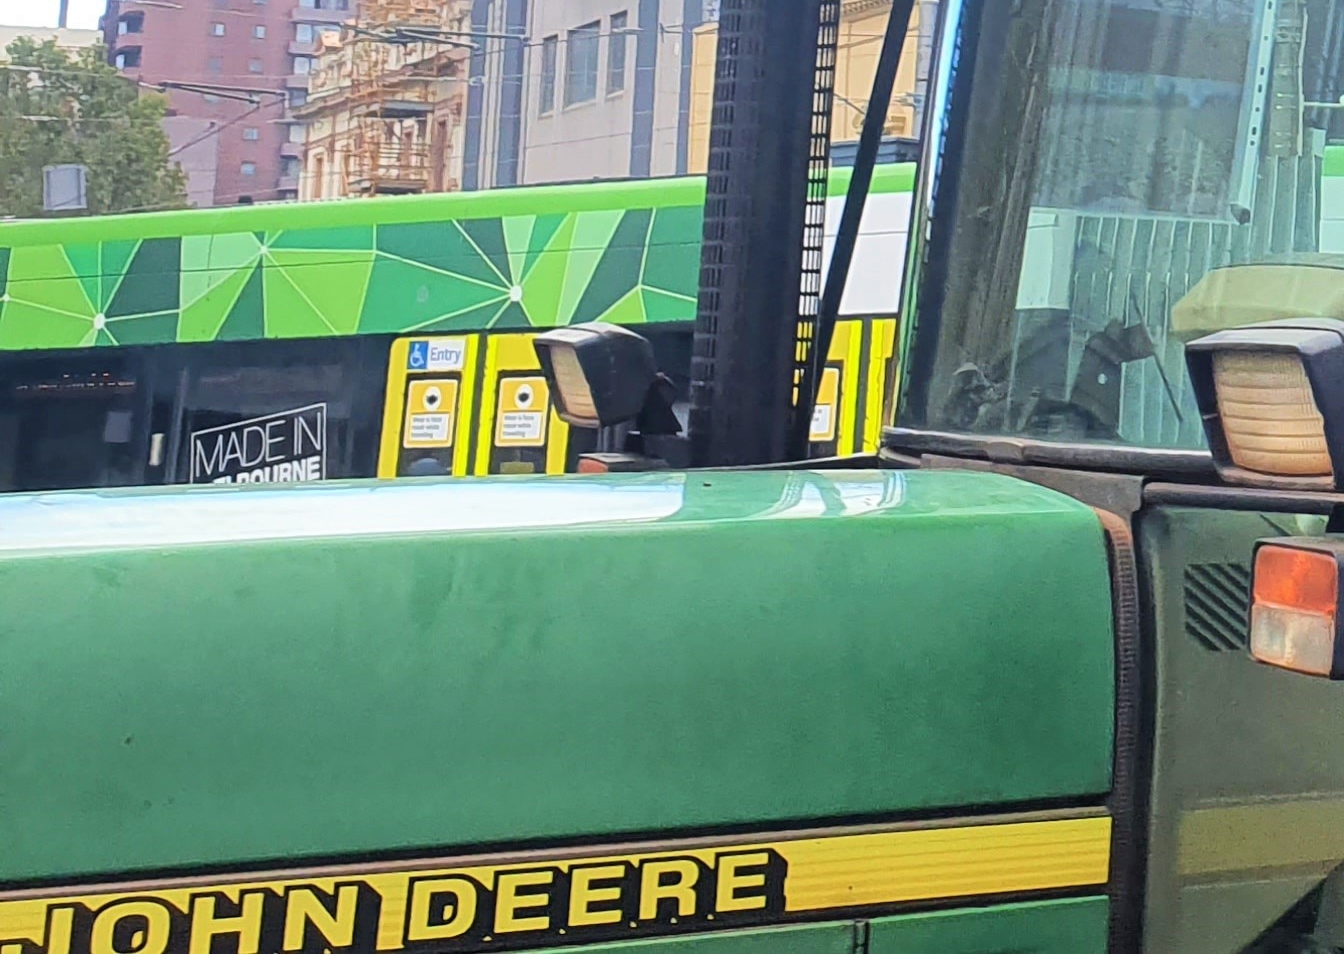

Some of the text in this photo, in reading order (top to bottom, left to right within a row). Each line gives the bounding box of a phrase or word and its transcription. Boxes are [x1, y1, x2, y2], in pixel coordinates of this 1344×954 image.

[430, 347, 461, 364] Entry
[196, 411, 321, 478] MADE IN
[1, 852, 770, 954] JOHN DEERE
